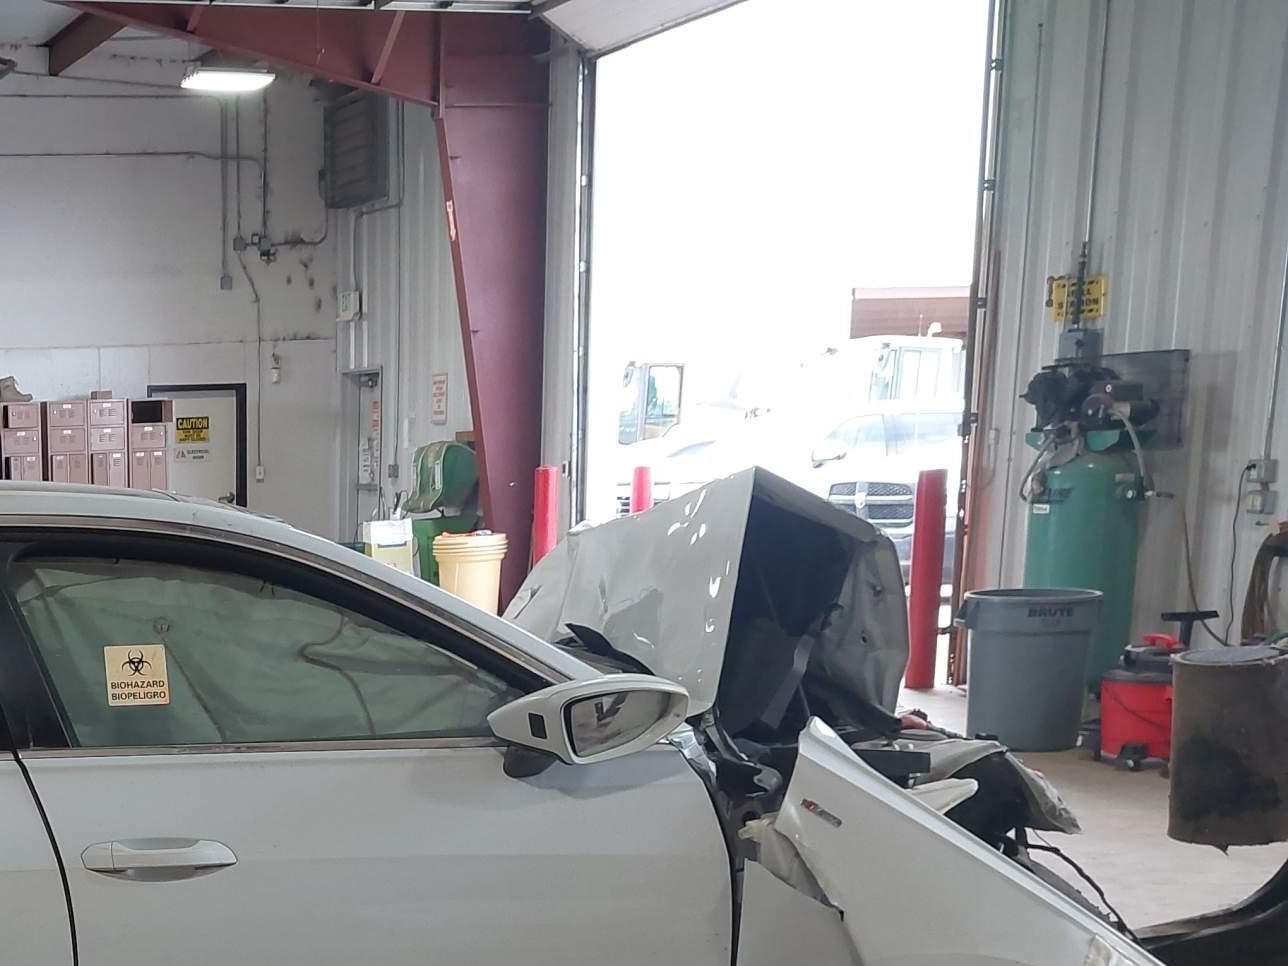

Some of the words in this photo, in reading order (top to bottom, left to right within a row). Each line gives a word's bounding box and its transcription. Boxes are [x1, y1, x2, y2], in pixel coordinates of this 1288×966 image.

[178, 418, 208, 429] CAUTION
[1027, 607, 1074, 618] BRUTE
[111, 680, 165, 690] BIOHAZARD
[111, 690, 166, 701] BIOPELIGRO
